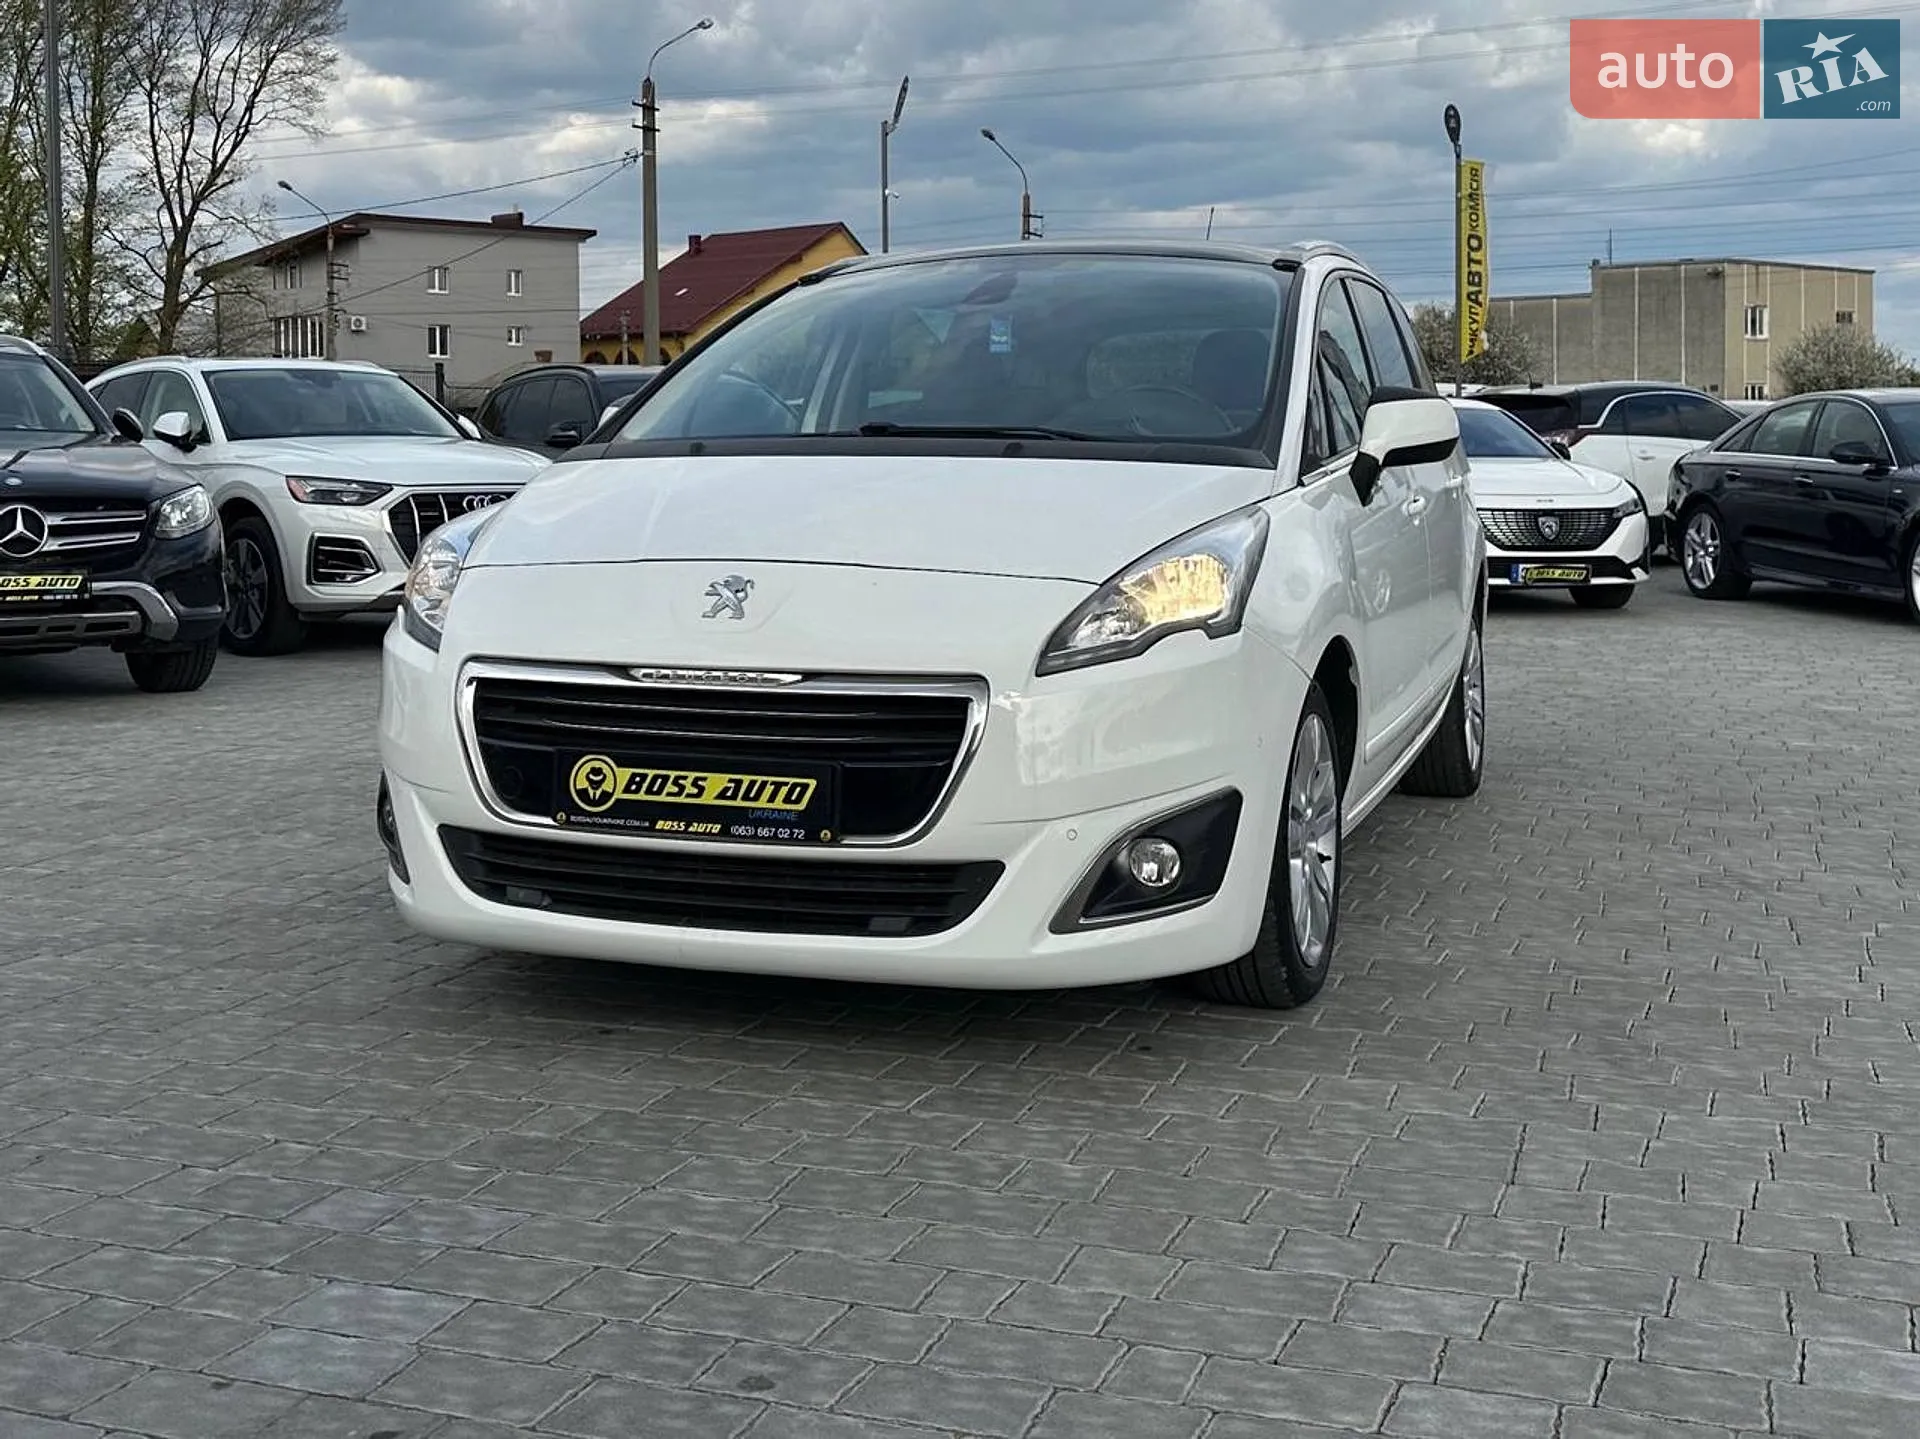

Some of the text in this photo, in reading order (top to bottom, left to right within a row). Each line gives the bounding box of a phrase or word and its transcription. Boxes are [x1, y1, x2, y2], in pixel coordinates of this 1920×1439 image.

[622, 772, 809, 804] BOSS AUTO
[748, 809, 799, 820] UKRAINE
[655, 820, 685, 831] BOSS
[688, 823, 722, 834] AUTO
[730, 826, 755, 836] (063)
[757, 827, 774, 837] 667
[777, 828, 790, 838] 02
[792, 829, 805, 839] 72
